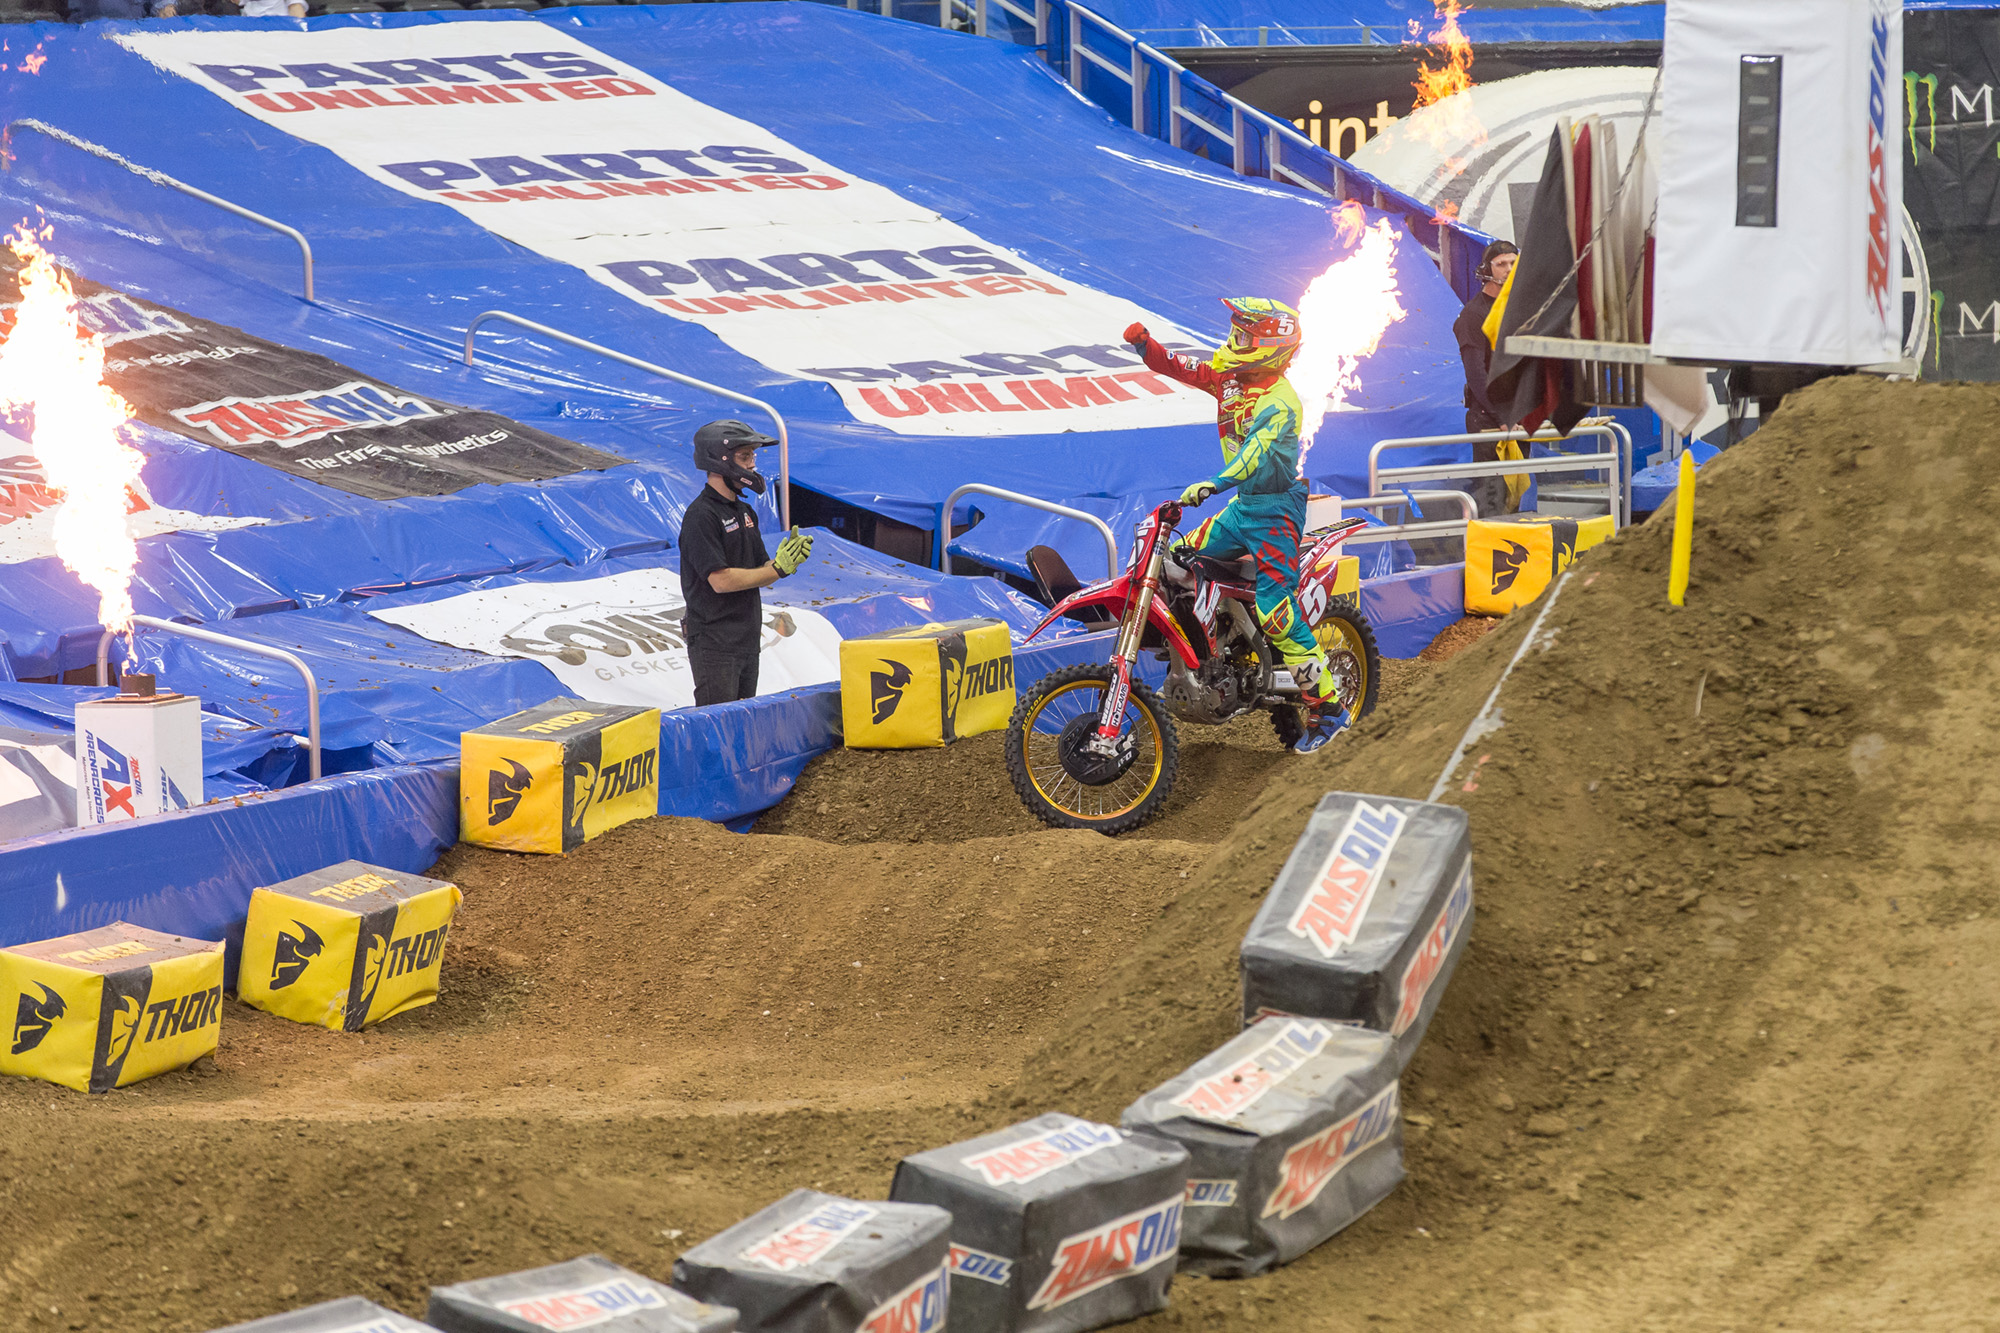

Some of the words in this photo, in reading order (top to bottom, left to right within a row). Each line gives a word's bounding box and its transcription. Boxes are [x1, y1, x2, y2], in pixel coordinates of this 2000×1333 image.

[192, 52, 619, 92] PARTS
[242, 78, 657, 113] UNLIMITED
[377, 146, 810, 190] PARTS
[437, 175, 849, 203] UNLIMITED
[1866, 10, 1889, 328] AMSOIL
[601, 245, 1027, 296] PARTS
[653, 275, 1067, 315] UNLIMITED
[1277, 318, 1295, 336] 5
[177, 384, 436, 446] AMSOIL
[857, 371, 1197, 418] UNLIMIT
[296, 456, 341, 471] The
[335, 443, 384, 465] Firs
[401, 429, 508, 459] Synthetics
[1301, 576, 1327, 627] 5
[594, 654, 690, 682] GASKE
[965, 655, 1013, 700] THOR
[517, 710, 605, 734] THOR
[1021, 693, 1044, 731] DUNLOP
[85, 729, 104, 824] ARENACROSS
[97, 736, 135, 818] AX
[130, 756, 143, 796] AMSOIL
[597, 748, 656, 804] THOR
[309, 873, 399, 903] THOR
[1291, 803, 1405, 954] AMSOIL
[386, 923, 448, 980] THOR
[1394, 856, 1471, 1034] AMSOIL
[144, 984, 221, 1043] THOR
[1174, 1023, 1330, 1118] AMSOIL
[963, 1122, 1120, 1185] AMSOIL
[1265, 1083, 1395, 1214] AMSOIL
[743, 1203, 876, 1268] AMSOIL
[1034, 1198, 1184, 1304] AMSOIL
[949, 1245, 1012, 1282] SOIL
[500, 1279, 665, 1332] AMSOIL
